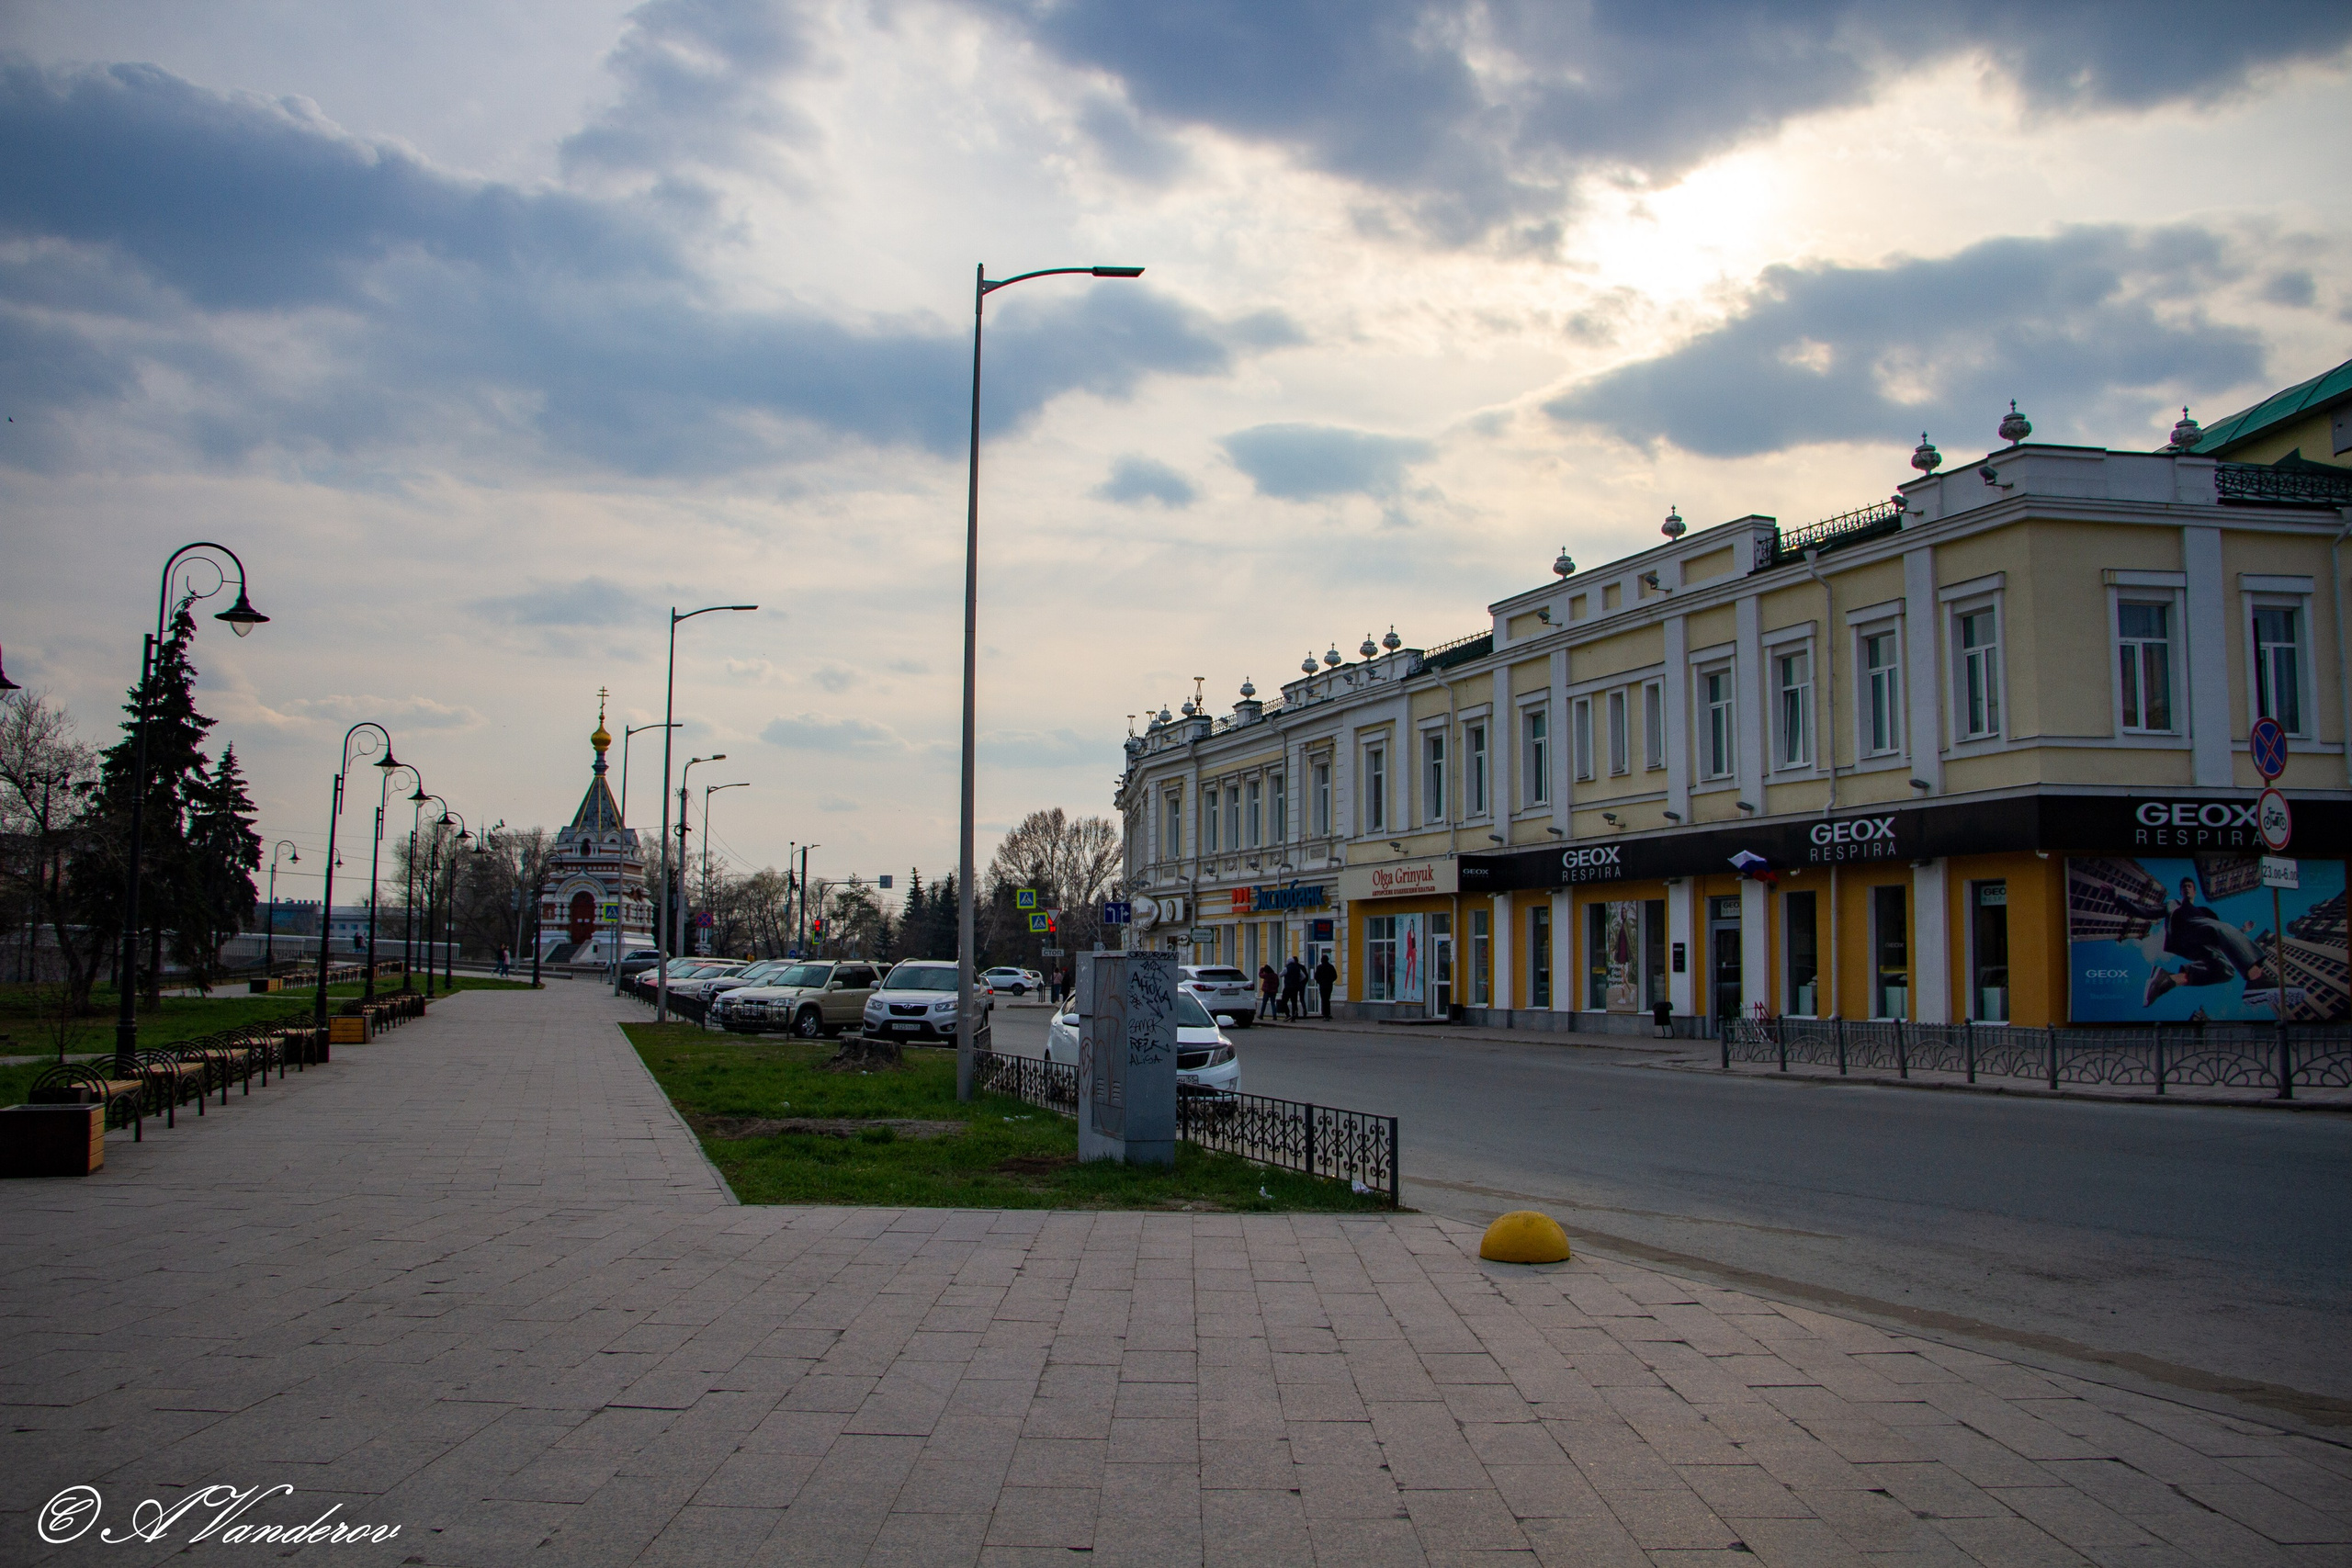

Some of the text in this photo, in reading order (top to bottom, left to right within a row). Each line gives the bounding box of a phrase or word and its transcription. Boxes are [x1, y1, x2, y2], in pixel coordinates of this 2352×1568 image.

[2135, 802, 2258, 827] GEOX
[1809, 817, 1896, 845] GEOX
[2135, 829, 2264, 846] RESPIRA
[1562, 846, 1621, 869] GEOX
[1809, 841, 1896, 862] RESPIRA
[1373, 863, 1434, 889] Olga Grinyuk
[1562, 865, 1622, 882] RESPIRA
[1253, 879, 1326, 911] Экспобанк
[2085, 969, 2129, 978] GEOX
